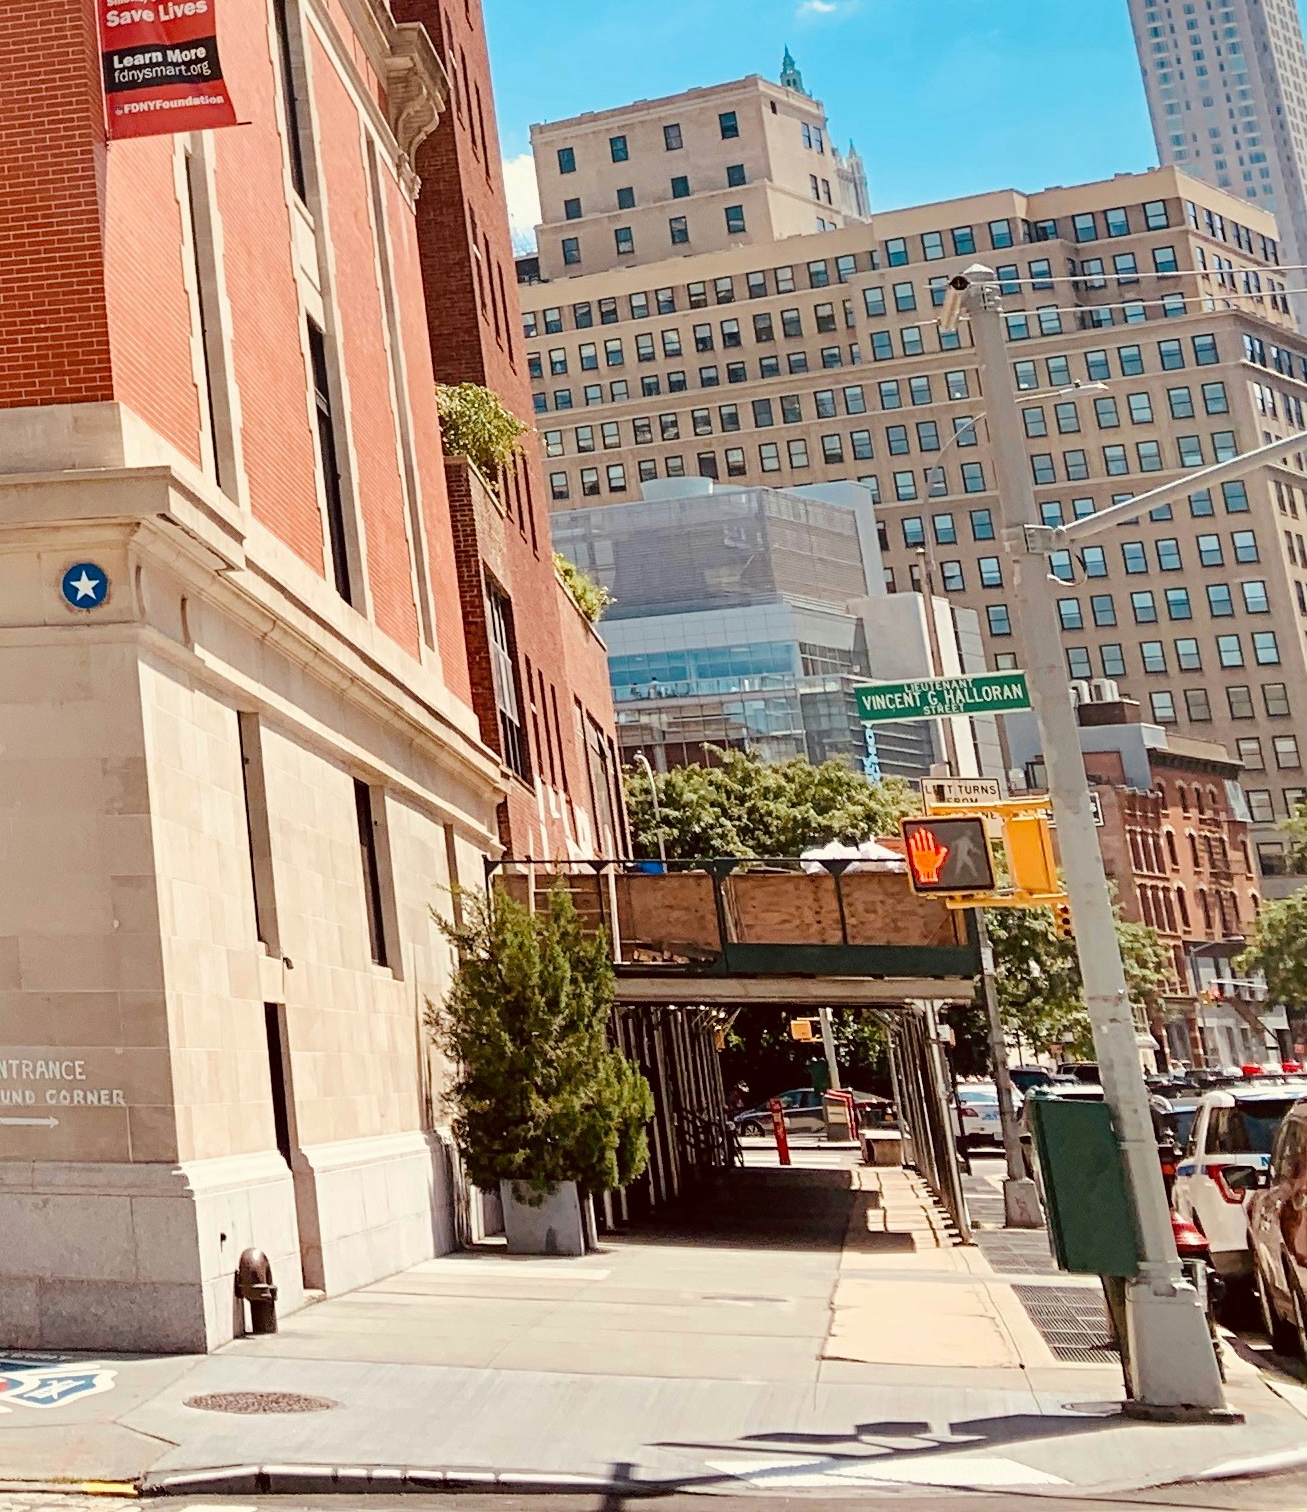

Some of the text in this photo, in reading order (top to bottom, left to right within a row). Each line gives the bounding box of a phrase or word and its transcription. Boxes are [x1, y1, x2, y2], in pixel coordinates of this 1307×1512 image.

[106, 0, 208, 27] Save Lives
[113, 47, 207, 69] Learn More
[114, 61, 211, 83] fdnysmart.org
[903, 678, 974, 694] LIEUTENANT
[861, 691, 921, 711] VINCENT
[944, 683, 1024, 706] HALLORAN
[922, 703, 965, 716] STREET
[926, 784, 997, 795] LT TURNS
[45, 1089, 127, 1106] CORNER
